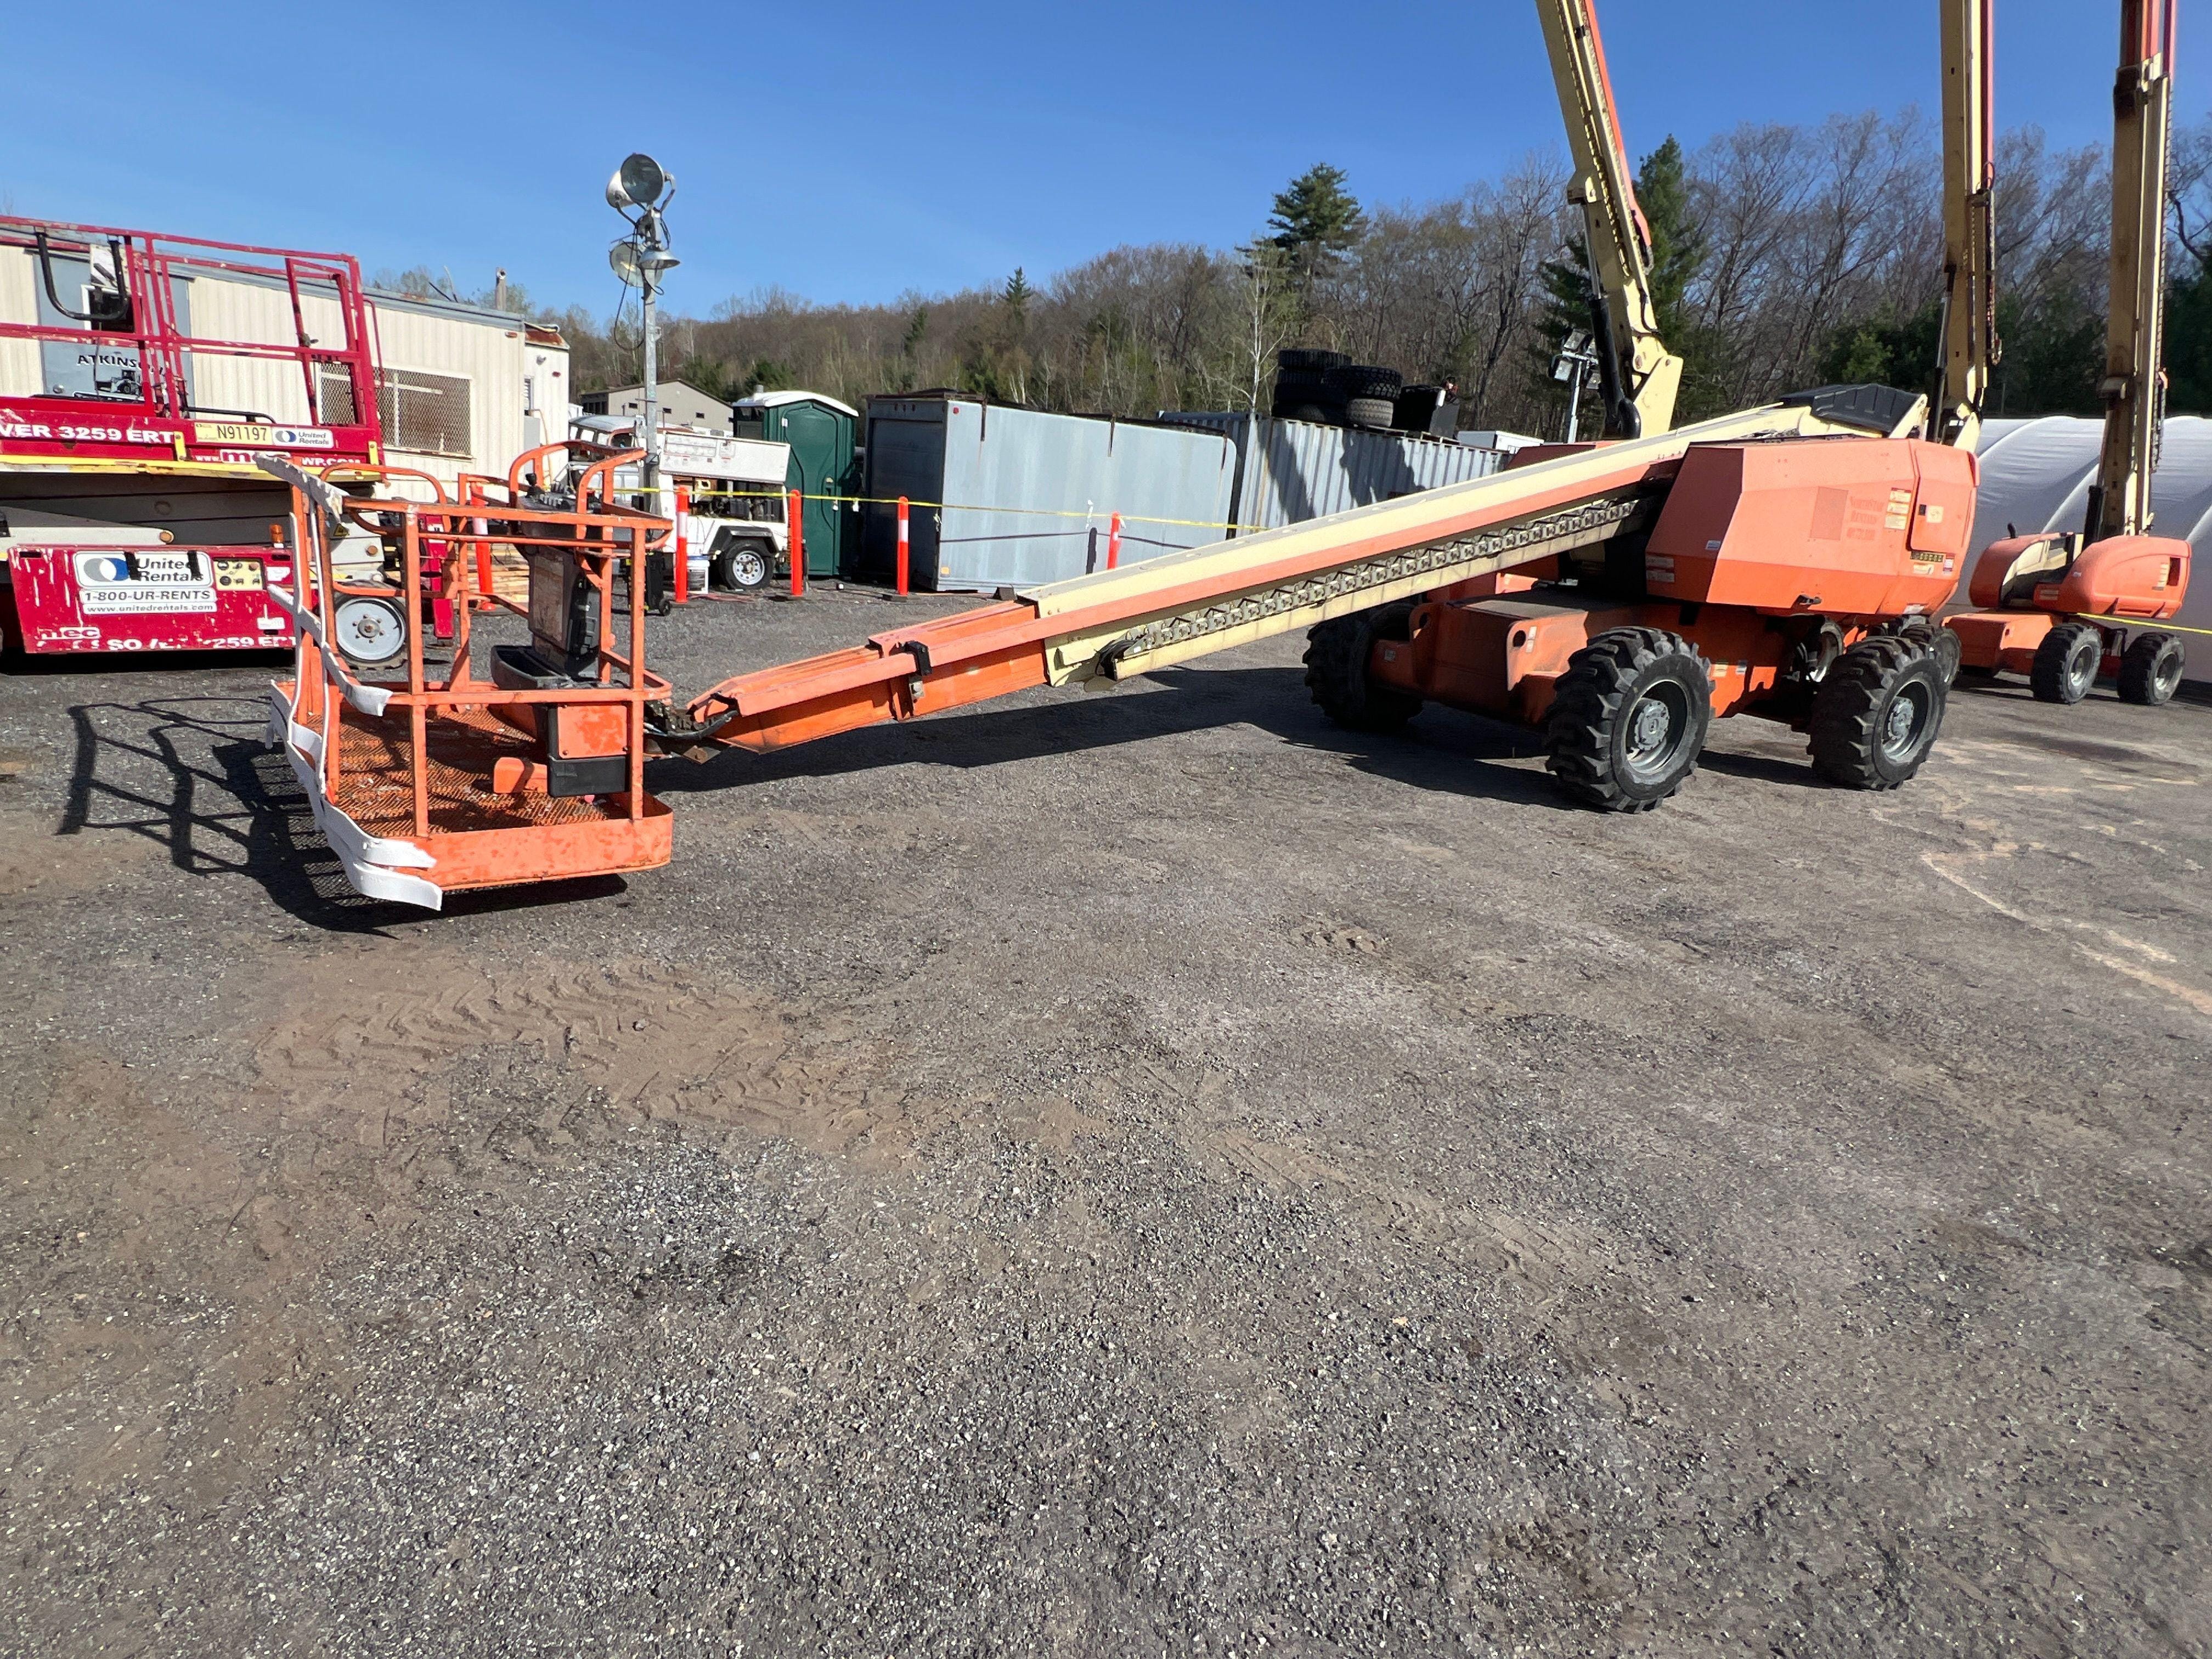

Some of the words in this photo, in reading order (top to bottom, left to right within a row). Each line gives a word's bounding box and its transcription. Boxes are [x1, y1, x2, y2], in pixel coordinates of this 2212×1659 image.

[58, 426, 122, 441] 3259
[127, 430, 174, 443] ERT
[217, 425, 267, 441] N91197
[85, 590, 211, 601] 1-800-UR-RENTS
[202, 636, 255, 648] 259
